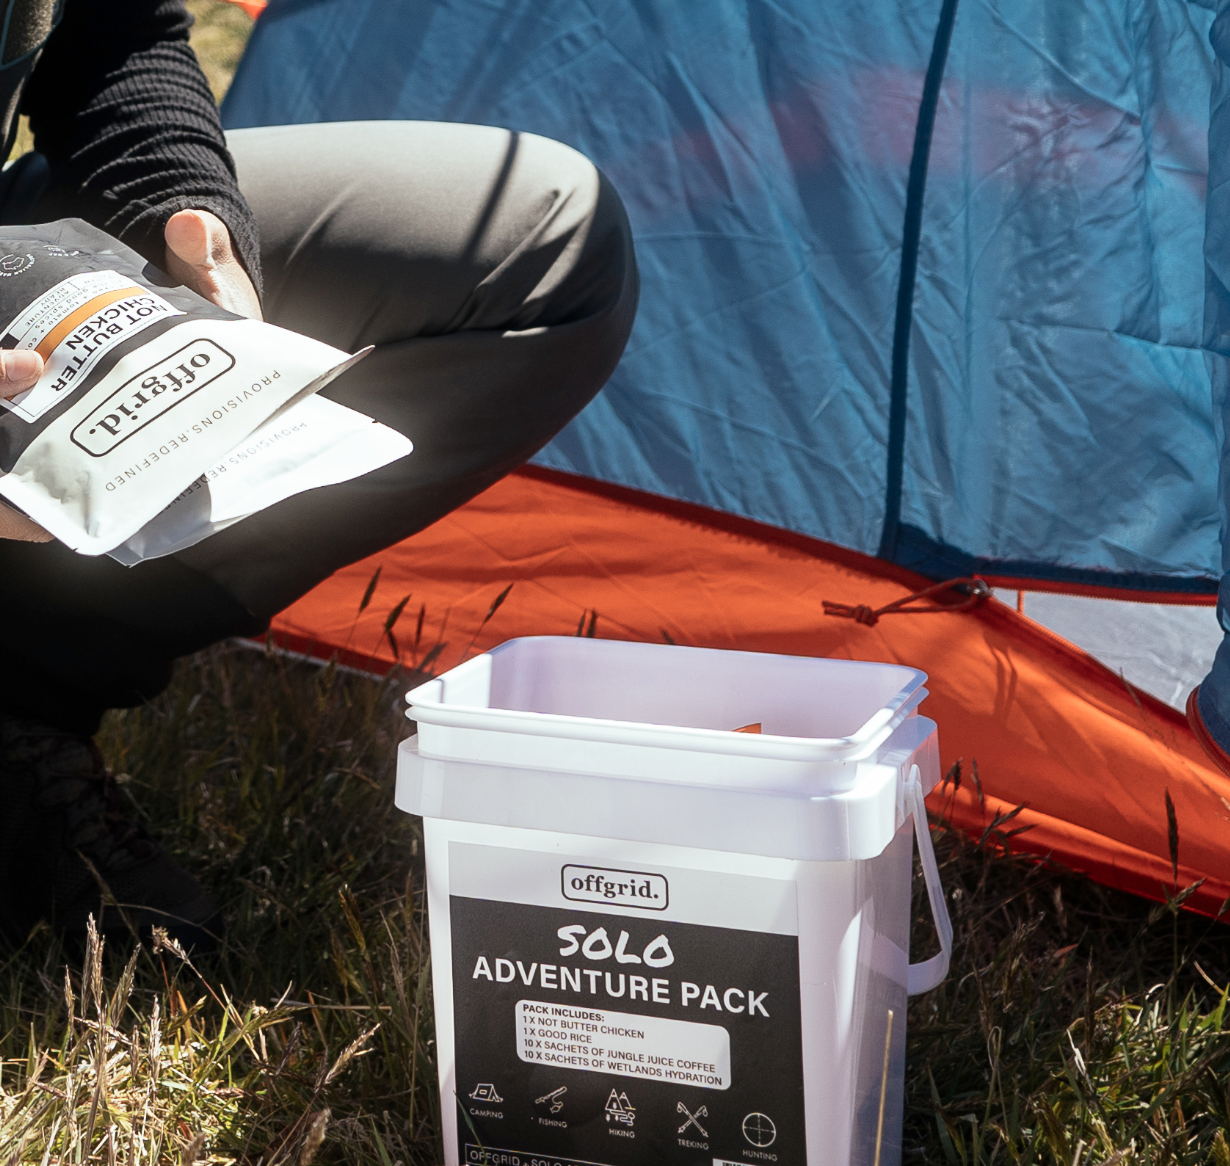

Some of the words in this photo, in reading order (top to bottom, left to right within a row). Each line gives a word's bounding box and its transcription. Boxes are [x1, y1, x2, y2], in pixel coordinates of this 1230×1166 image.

[65, 297, 156, 351] CHICKEN
[125, 304, 168, 326] NOT
[50, 323, 124, 392] BUTTER
[88, 352, 211, 437] offgrid.
[570, 874, 659, 899] offgrid.
[557, 924, 675, 968] SOLO
[472, 955, 671, 1004] ADVENTURE
[681, 981, 771, 1019] PACK
[523, 1004, 549, 1015] PACK
[551, 1008, 605, 1022] INCLUDES:
[523, 1015, 527, 1024] 1
[529, 1016, 536, 1024] X
[538, 1017, 557, 1027] NOT
[560, 1020, 598, 1033] BUTTER
[600, 1025, 645, 1039] CHICKEN
[523, 1027, 527, 1035] 1
[529, 1028, 536, 1036] X
[538, 1029, 567, 1040] GOOD
[570, 1032, 592, 1044] RICE
[524, 1038, 534, 1047] 10
[535, 1040, 542, 1048] X
[544, 1041, 589, 1055] SACHETS
[591, 1047, 605, 1057] OF
[607, 1049, 645, 1063] JUNGLE
[647, 1055, 674, 1067] JUICE
[676, 1059, 716, 1073] COFFEE
[524, 1050, 534, 1059] 10
[536, 1051, 543, 1060] X
[544, 1052, 589, 1066] SACHETS
[591, 1059, 605, 1068] OF
[607, 1061, 662, 1078] WETLANDS
[665, 1069, 723, 1086] HYDRATION
[470, 1107, 504, 1119] CAMPING
[538, 1117, 568, 1128] FISHING
[608, 1128, 635, 1139] HIKING
[677, 1138, 709, 1151] TREKING
[742, 1149, 778, 1162] HUNTING
